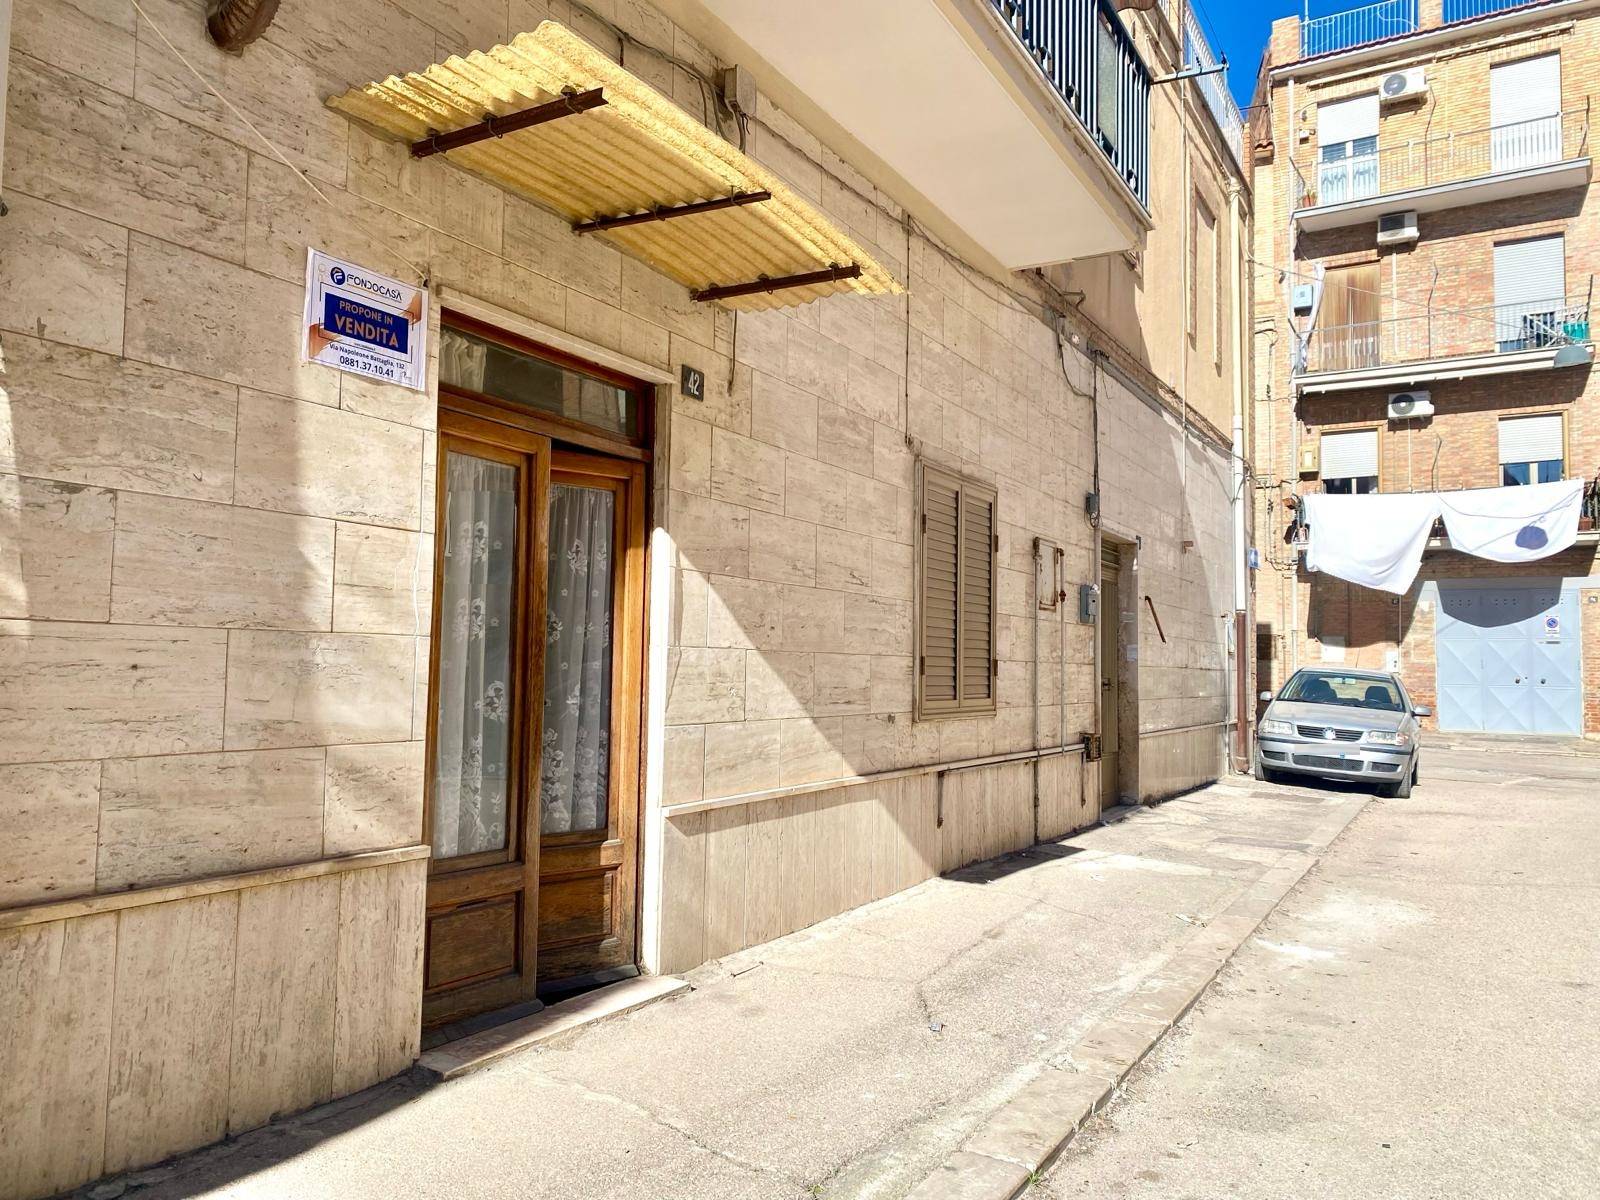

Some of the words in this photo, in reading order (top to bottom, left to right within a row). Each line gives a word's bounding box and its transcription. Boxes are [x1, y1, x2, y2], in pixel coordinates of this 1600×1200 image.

[346, 273, 403, 301] FONDOCASA
[339, 300, 382, 322] PROPONE
[384, 315, 393, 325] IN
[334, 313, 399, 348] VENDITA
[329, 343, 339, 351] Via
[339, 346, 369, 360] Napoleone
[339, 355, 394, 378] 0881.37.10.41
[688, 371, 700, 395] 42
